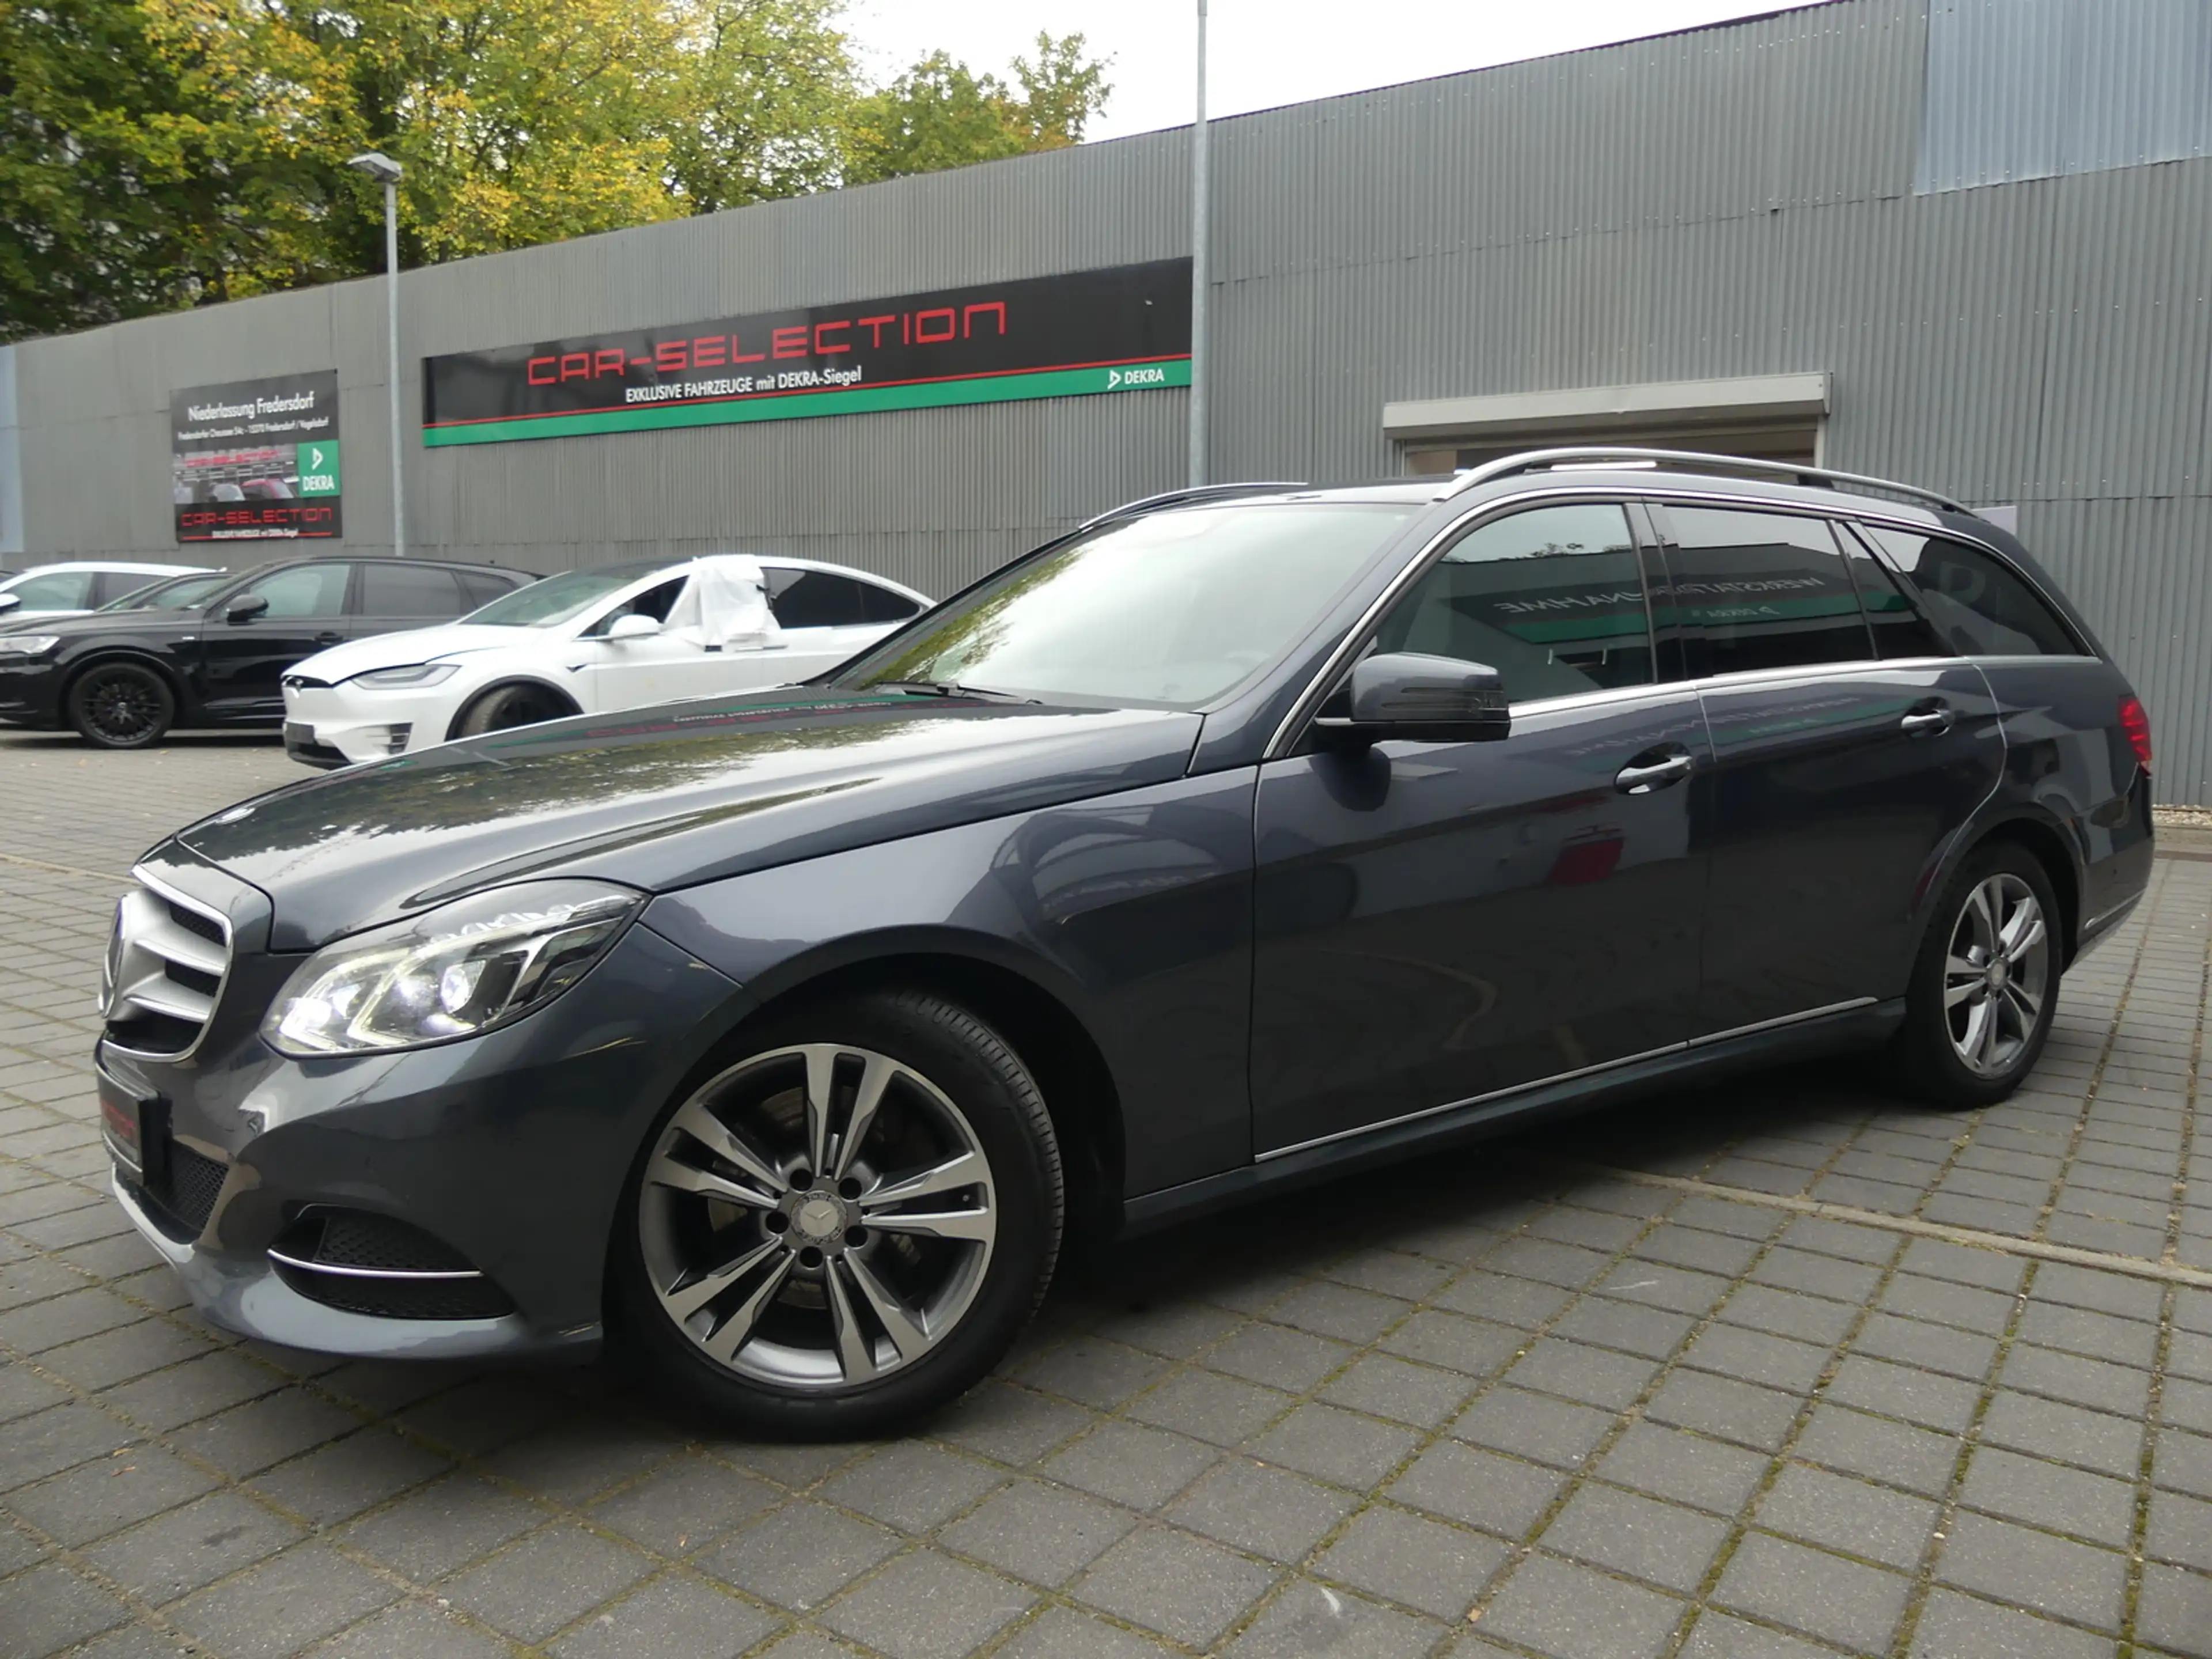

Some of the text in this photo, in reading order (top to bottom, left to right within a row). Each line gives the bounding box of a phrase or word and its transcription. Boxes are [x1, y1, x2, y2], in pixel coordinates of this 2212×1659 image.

[527, 301, 1005, 385] CAR-SELECTION
[626, 365, 862, 403] EXKLUSIVE FAHRZEUGE mit DEKRA-Siegel
[1124, 368, 1164, 385] DEKRA
[188, 391, 315, 422] Niederlassung Fredersdorf
[302, 475, 335, 492] DEKRA
[181, 507, 332, 528] CAR-SELECTION
